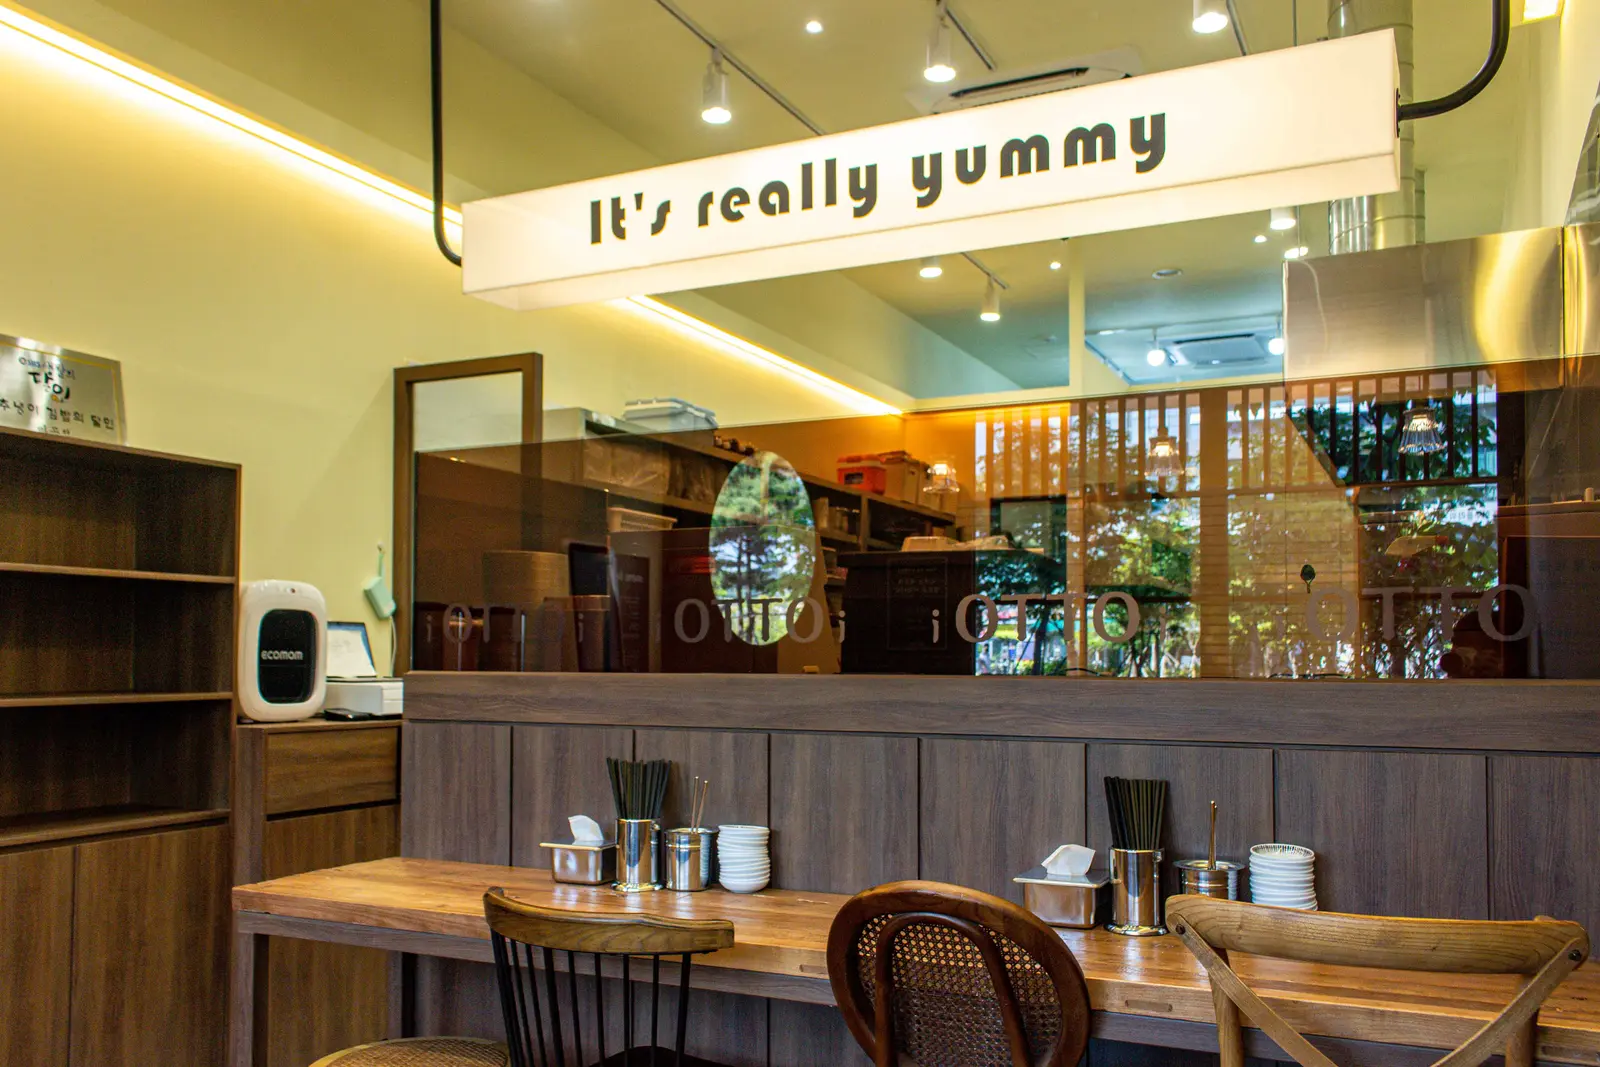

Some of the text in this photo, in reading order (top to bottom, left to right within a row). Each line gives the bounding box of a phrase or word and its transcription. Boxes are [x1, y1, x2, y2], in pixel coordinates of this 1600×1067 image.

[590, 112, 1166, 244] It's really yummy
[956, 592, 1140, 643] OTTO
